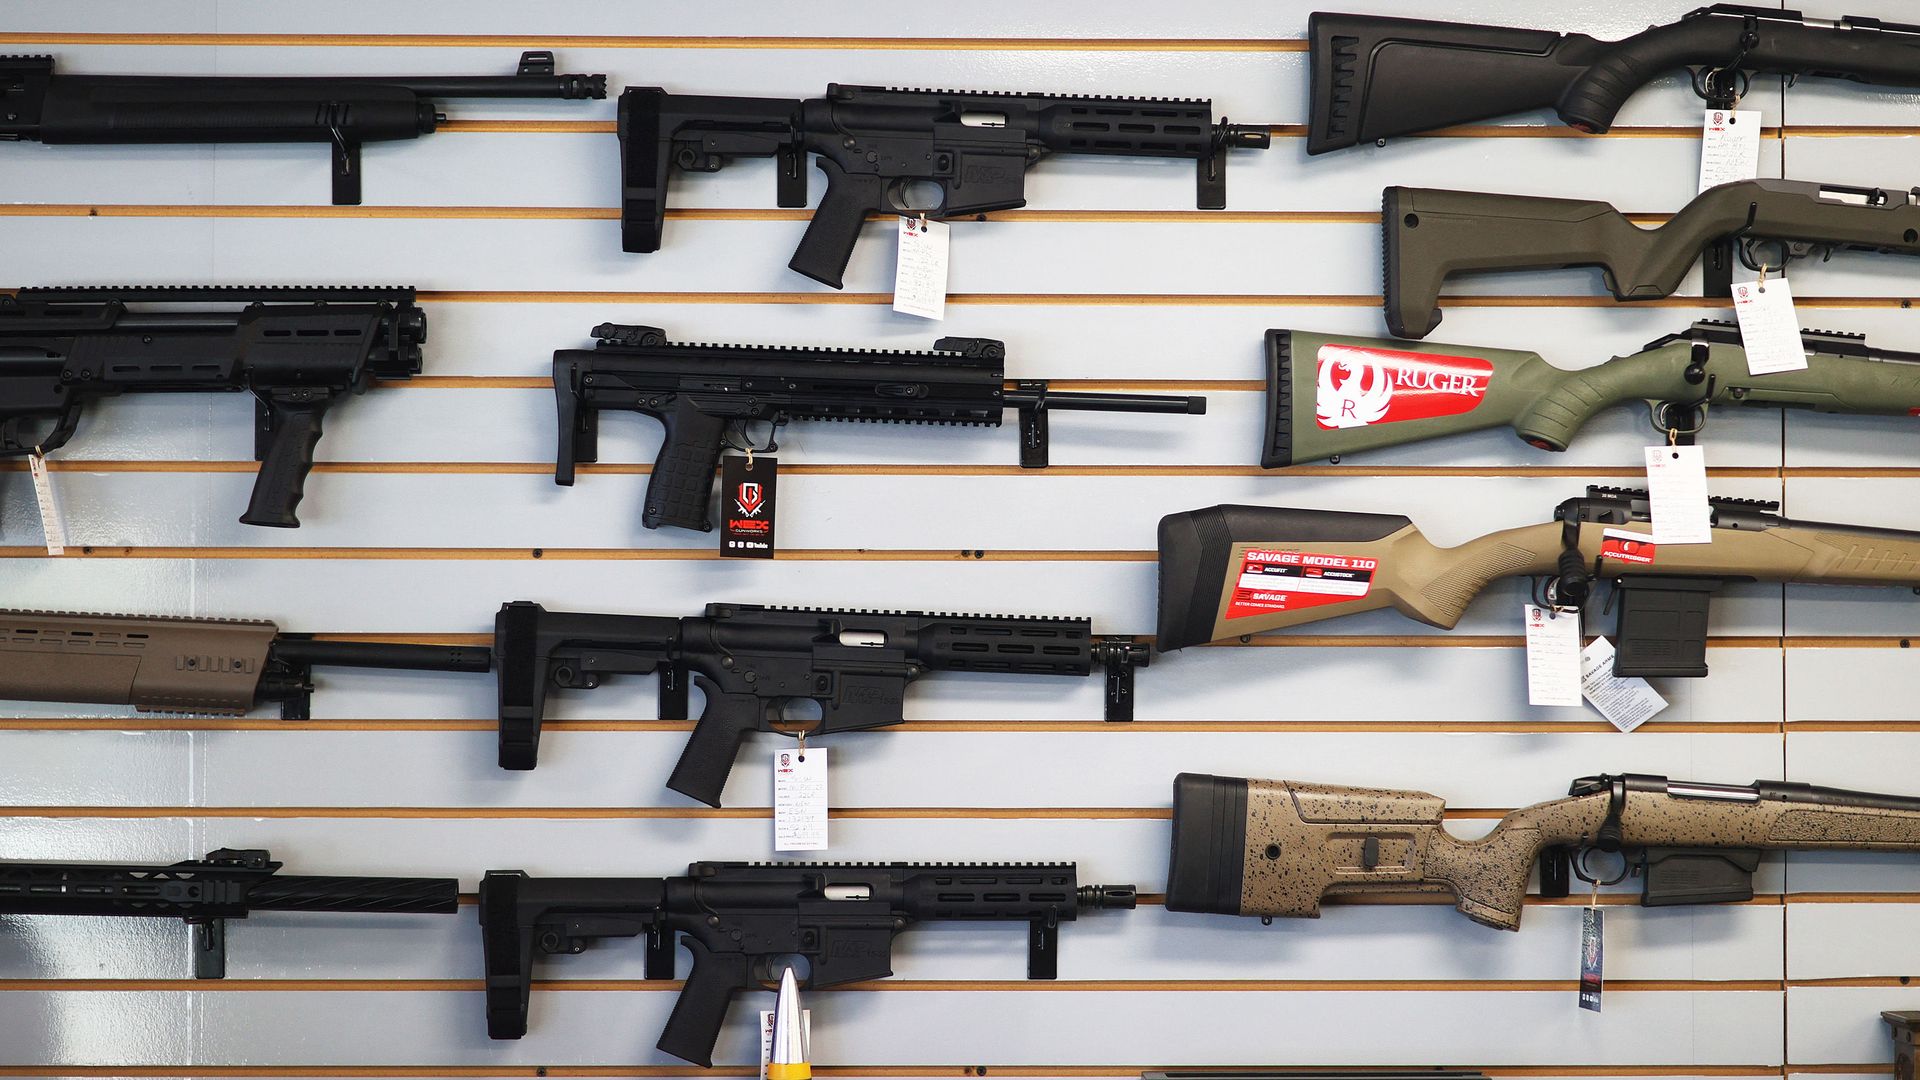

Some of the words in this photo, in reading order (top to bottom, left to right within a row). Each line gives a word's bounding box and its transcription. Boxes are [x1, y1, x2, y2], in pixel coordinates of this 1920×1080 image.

[1395, 367, 1479, 397] RUGER
[1341, 399, 1356, 419] R
[730, 519, 769, 529] WEX
[1247, 551, 1300, 564] SAVAGE
[1302, 556, 1349, 568] MODEL
[1351, 559, 1376, 569] 110
[1604, 551, 1652, 563] ACCUTRIGGER
[1253, 593, 1287, 601] SAVAGE
